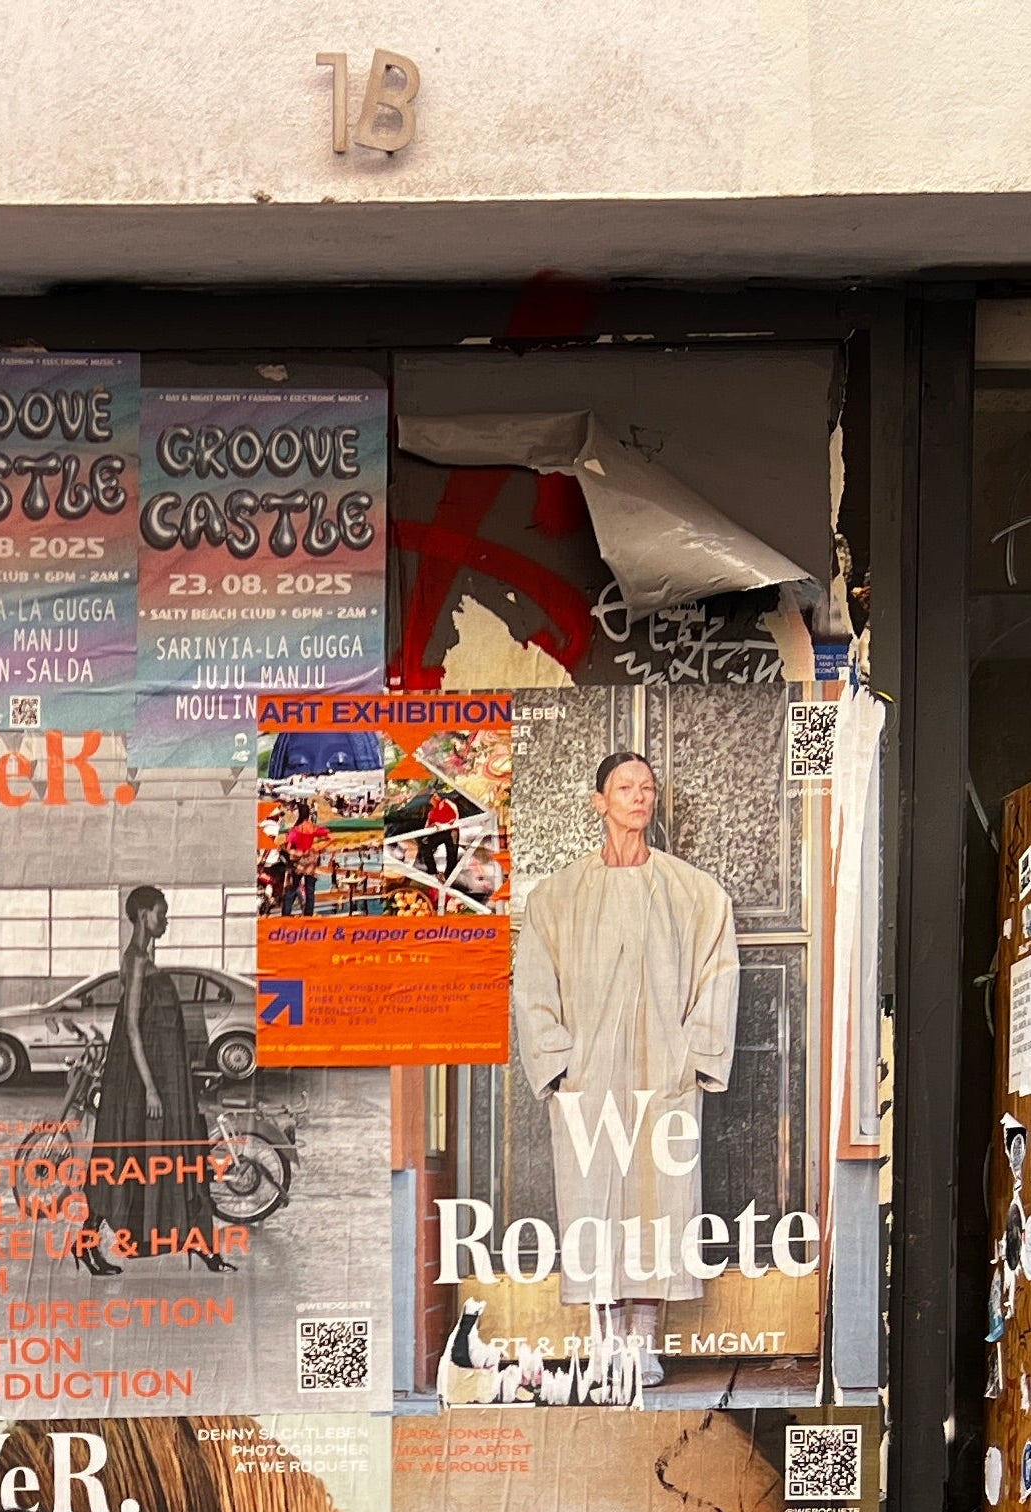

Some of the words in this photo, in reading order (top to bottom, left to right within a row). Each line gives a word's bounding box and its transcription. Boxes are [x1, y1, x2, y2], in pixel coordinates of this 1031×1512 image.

[316, 48, 420, 152] 1B
[157, 423, 361, 480] GROOVE
[140, 489, 375, 559] CASTLE
[30, 536, 105, 558] 2025
[45, 571, 75, 583] 6PM
[90, 571, 118, 582] 2AM
[53, 599, 116, 621] GUGGA
[13, 628, 78, 652] MANJU
[259, 702, 322, 723] ART
[332, 701, 512, 723] EXHIBITION
[268, 927, 327, 943] digital
[333, 927, 346, 941] &
[352, 927, 408, 944] paper
[414, 926, 497, 943] collages
[556, 1088, 700, 1179] We
[45, 1229, 99, 1260] UP
[112, 1228, 138, 1257] &
[149, 1225, 249, 1255] HAIR
[433, 1198, 820, 1305] Roquete
[9, 1299, 233, 1331] DIRECTION
[691, 1332, 785, 1354] MGMT
[198, 1428, 254, 1441] DENNY
[258, 1426, 368, 1441] SACHTLEBEN
[446, 1429, 524, 1440] FONSECA
[231, 1444, 368, 1458] PHOTOGRAPHER
[472, 1445, 532, 1456] ARTIST
[235, 1460, 256, 1473] AT
[260, 1460, 285, 1473] WE
[290, 1460, 368, 1473] ROQUETE
[450, 1461, 529, 1472] ROQUETE
